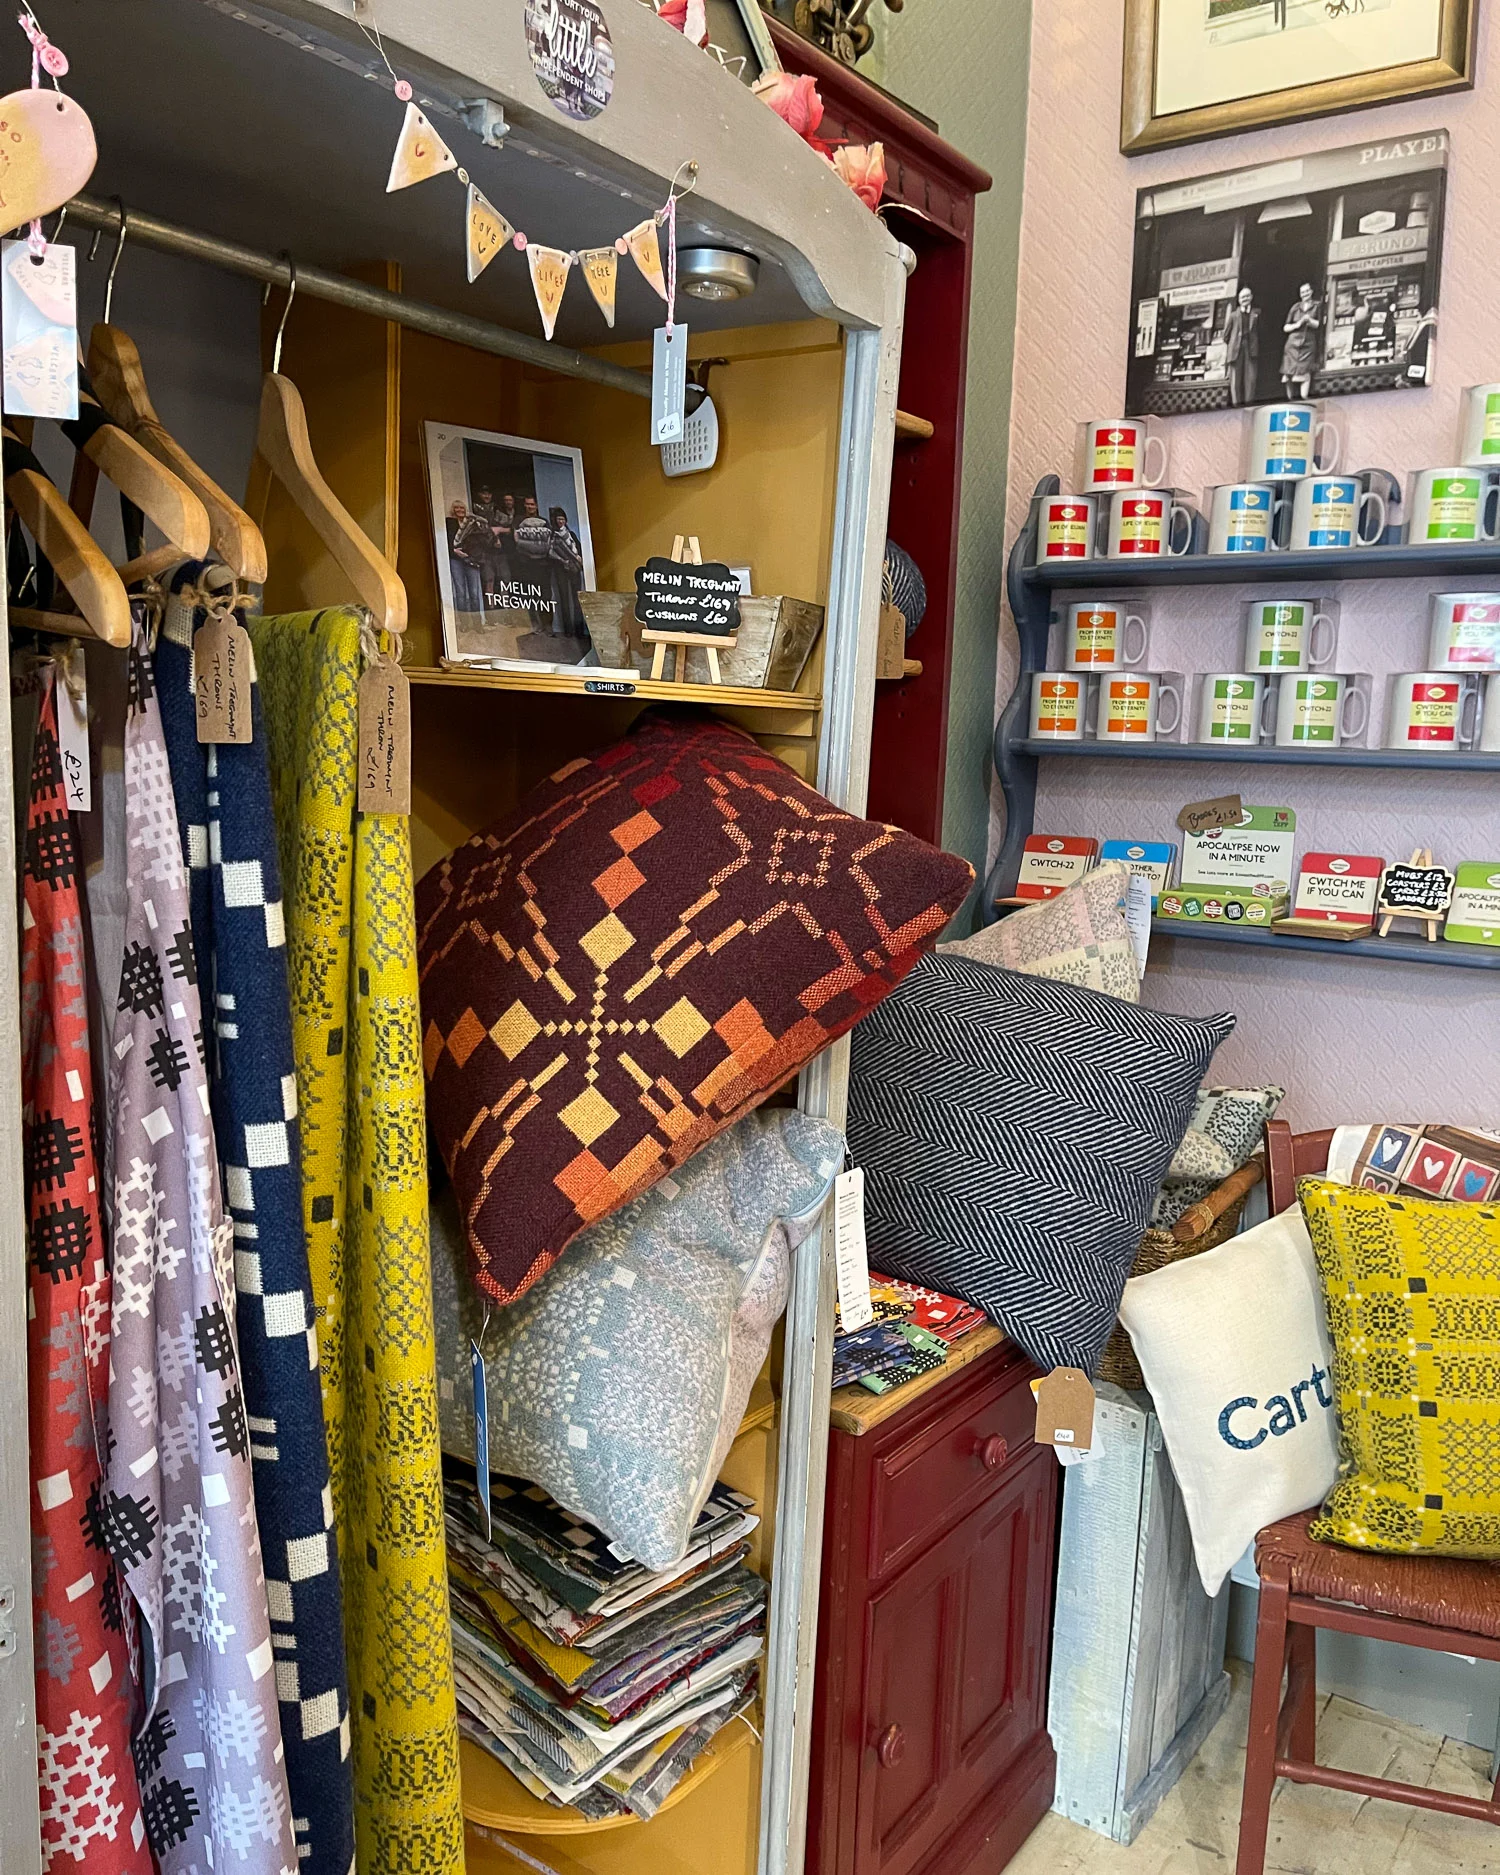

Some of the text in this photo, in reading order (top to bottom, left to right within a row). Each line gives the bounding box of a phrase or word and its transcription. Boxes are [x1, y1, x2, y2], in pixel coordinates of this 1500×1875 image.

[580, 5, 600, 24] YOUR
[545, 0, 597, 77] little
[535, 57, 606, 102] INDEPENDENT SHOPS
[472, 213, 496, 244] LOVE
[538, 270, 564, 287] LIVES
[500, 580, 542, 597] MELIN
[642, 572, 682, 587] MELIN
[485, 592, 557, 614] TREGWYNT
[644, 592, 731, 612] THROWS £169
[645, 610, 728, 624] CUSHIONS £60
[228, 634, 236, 678] MELIN
[212, 653, 222, 710] THROWS
[597, 683, 624, 692] SHIRTS
[196, 676, 208, 718] £169
[64, 750, 83, 802] £24
[365, 747, 380, 789] £169
[1196, 842, 1280, 853] APOCALYPSE NOW
[1030, 858, 1074, 870] CWTCH-22
[1209, 852, 1218, 860] IN
[1229, 854, 1266, 864] MINUTE
[1308, 876, 1366, 888] CWTCH ME
[1396, 870, 1444, 882] MUGS £12
[1306, 887, 1364, 899] IF YOU CAN
[1432, 882, 1446, 890] £3
[1218, 1363, 1332, 1450] Cart
